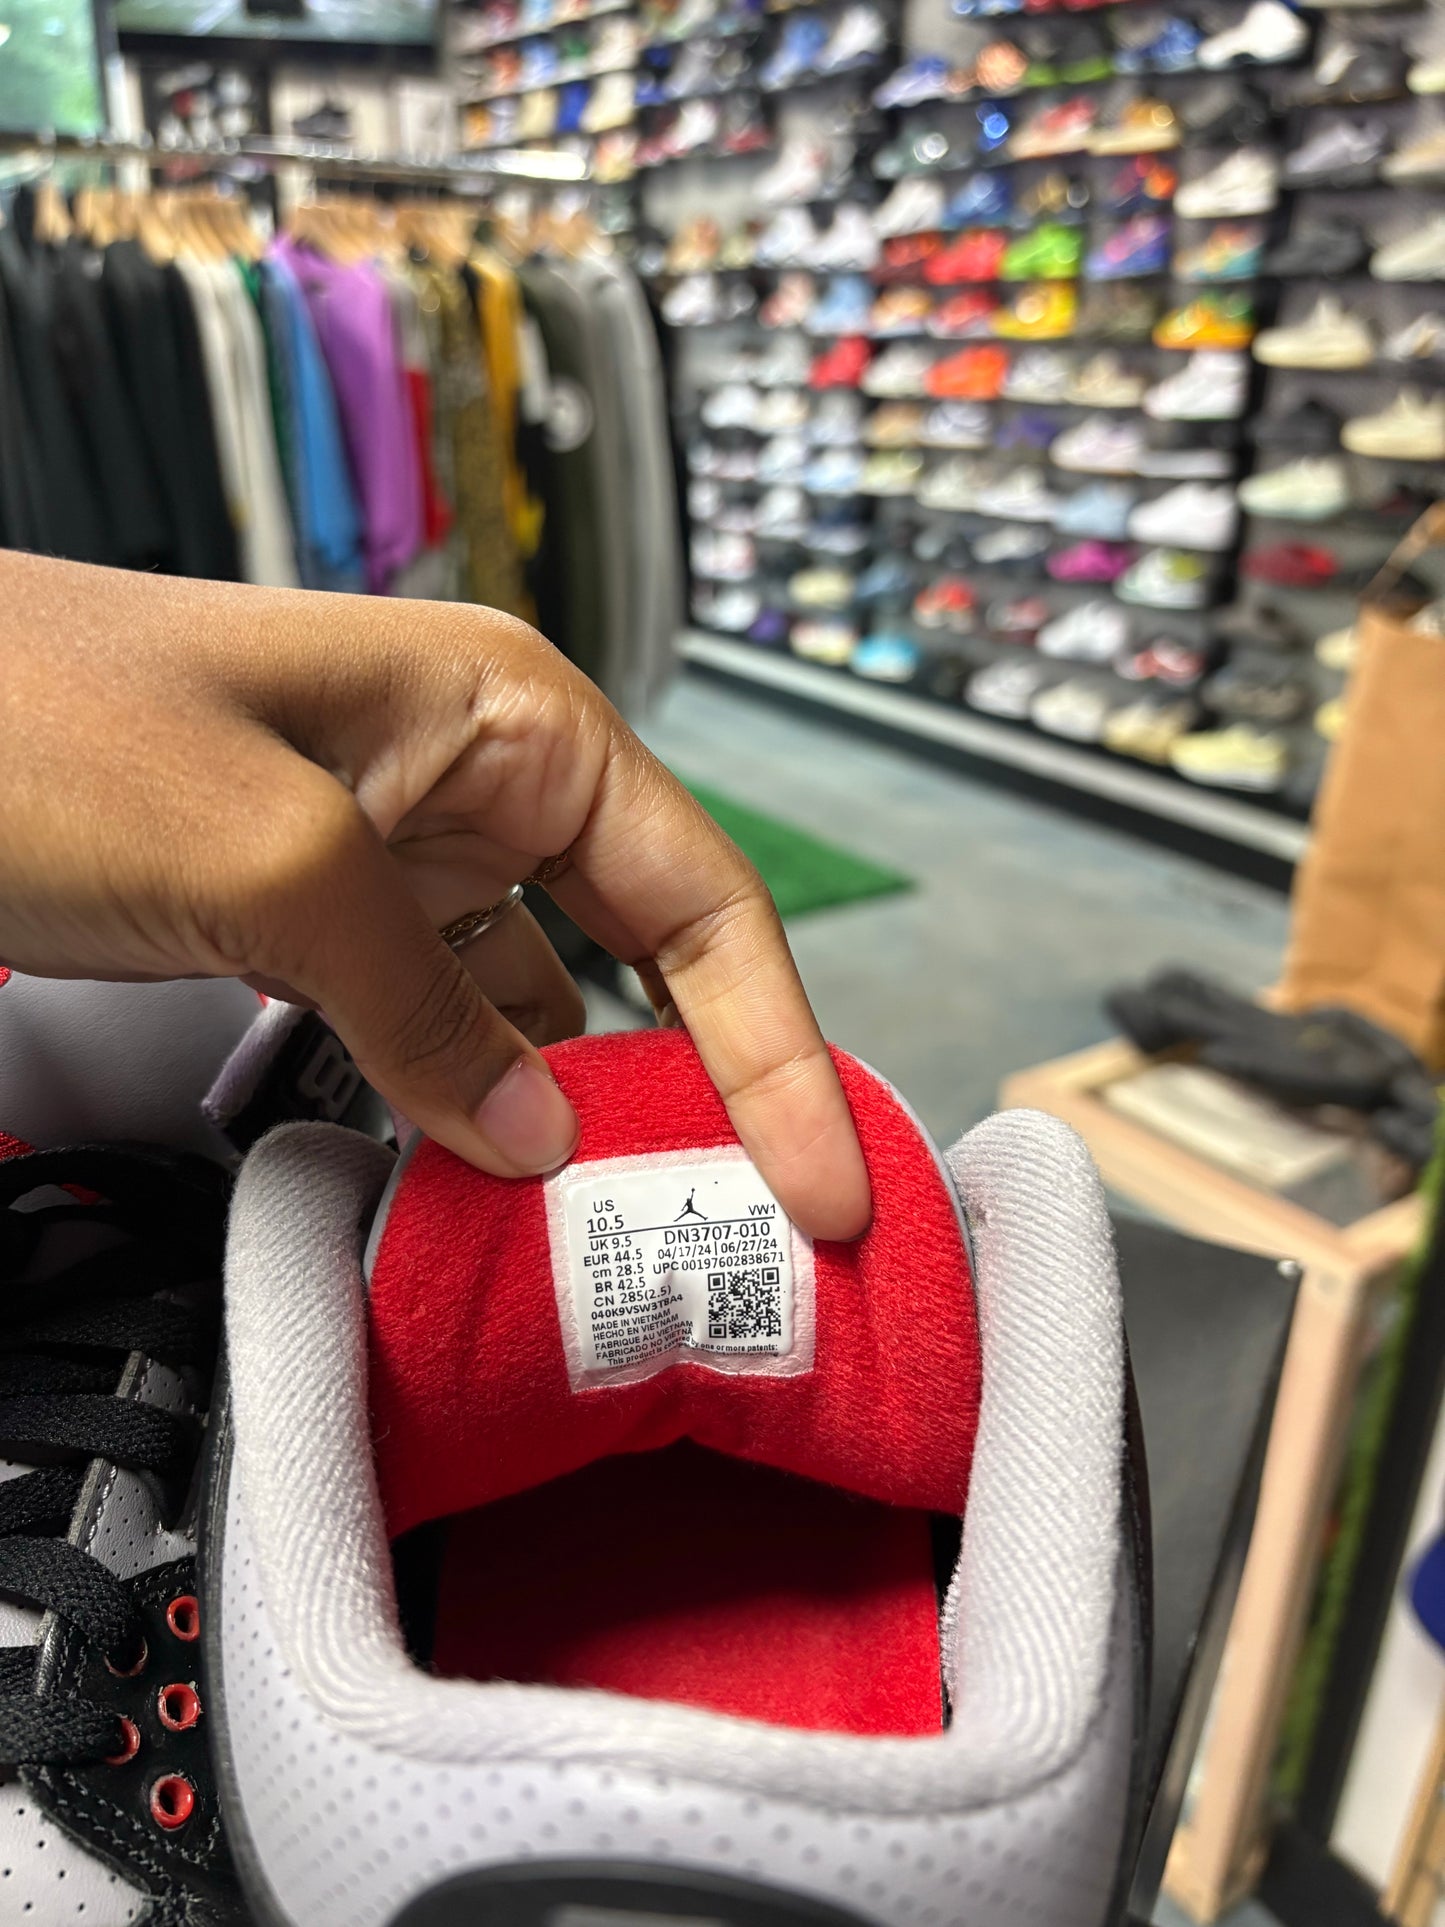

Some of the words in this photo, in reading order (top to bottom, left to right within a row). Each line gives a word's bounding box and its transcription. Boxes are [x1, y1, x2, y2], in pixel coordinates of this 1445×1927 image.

[593, 1199, 615, 1213] US
[748, 1203, 777, 1216] VW1
[586, 1214, 624, 1234] 10.5
[664, 1222, 770, 1245] DN3707-010
[590, 1238, 609, 1251] UK
[611, 1235, 632, 1249] 9.5
[583, 1253, 610, 1267] EUR
[614, 1248, 643, 1263] 44.5
[652, 1261, 679, 1275] UPC
[681, 1251, 785, 1271] 00197602838671
[592, 1268, 612, 1279] cm
[615, 1262, 644, 1277] 28.5
[595, 1280, 614, 1293] BR
[617, 1276, 646, 1291] 42.5
[593, 1295, 615, 1307] CN
[619, 1284, 672, 1304] 285(2.5)
[592, 1320, 619, 1332] MADE
[621, 1317, 630, 1327] IN
[632, 1308, 671, 1326] VIETNAM
[593, 1328, 625, 1341] HECHO
[627, 1326, 639, 1336] EN
[641, 1313, 679, 1333] VIETNAM
[595, 1336, 640, 1351] FABRIQUE
[642, 1332, 655, 1342] AU
[656, 1320, 693, 1339] VIETNAM
[596, 1343, 648, 1360] FABRICADO
[650, 1339, 663, 1348] NO
[607, 1357, 624, 1366] This
[626, 1349, 656, 1363] product
[656, 1345, 663, 1353] is
[700, 1343, 714, 1351] one
[725, 1344, 745, 1352] more
[747, 1343, 778, 1353] patents:
